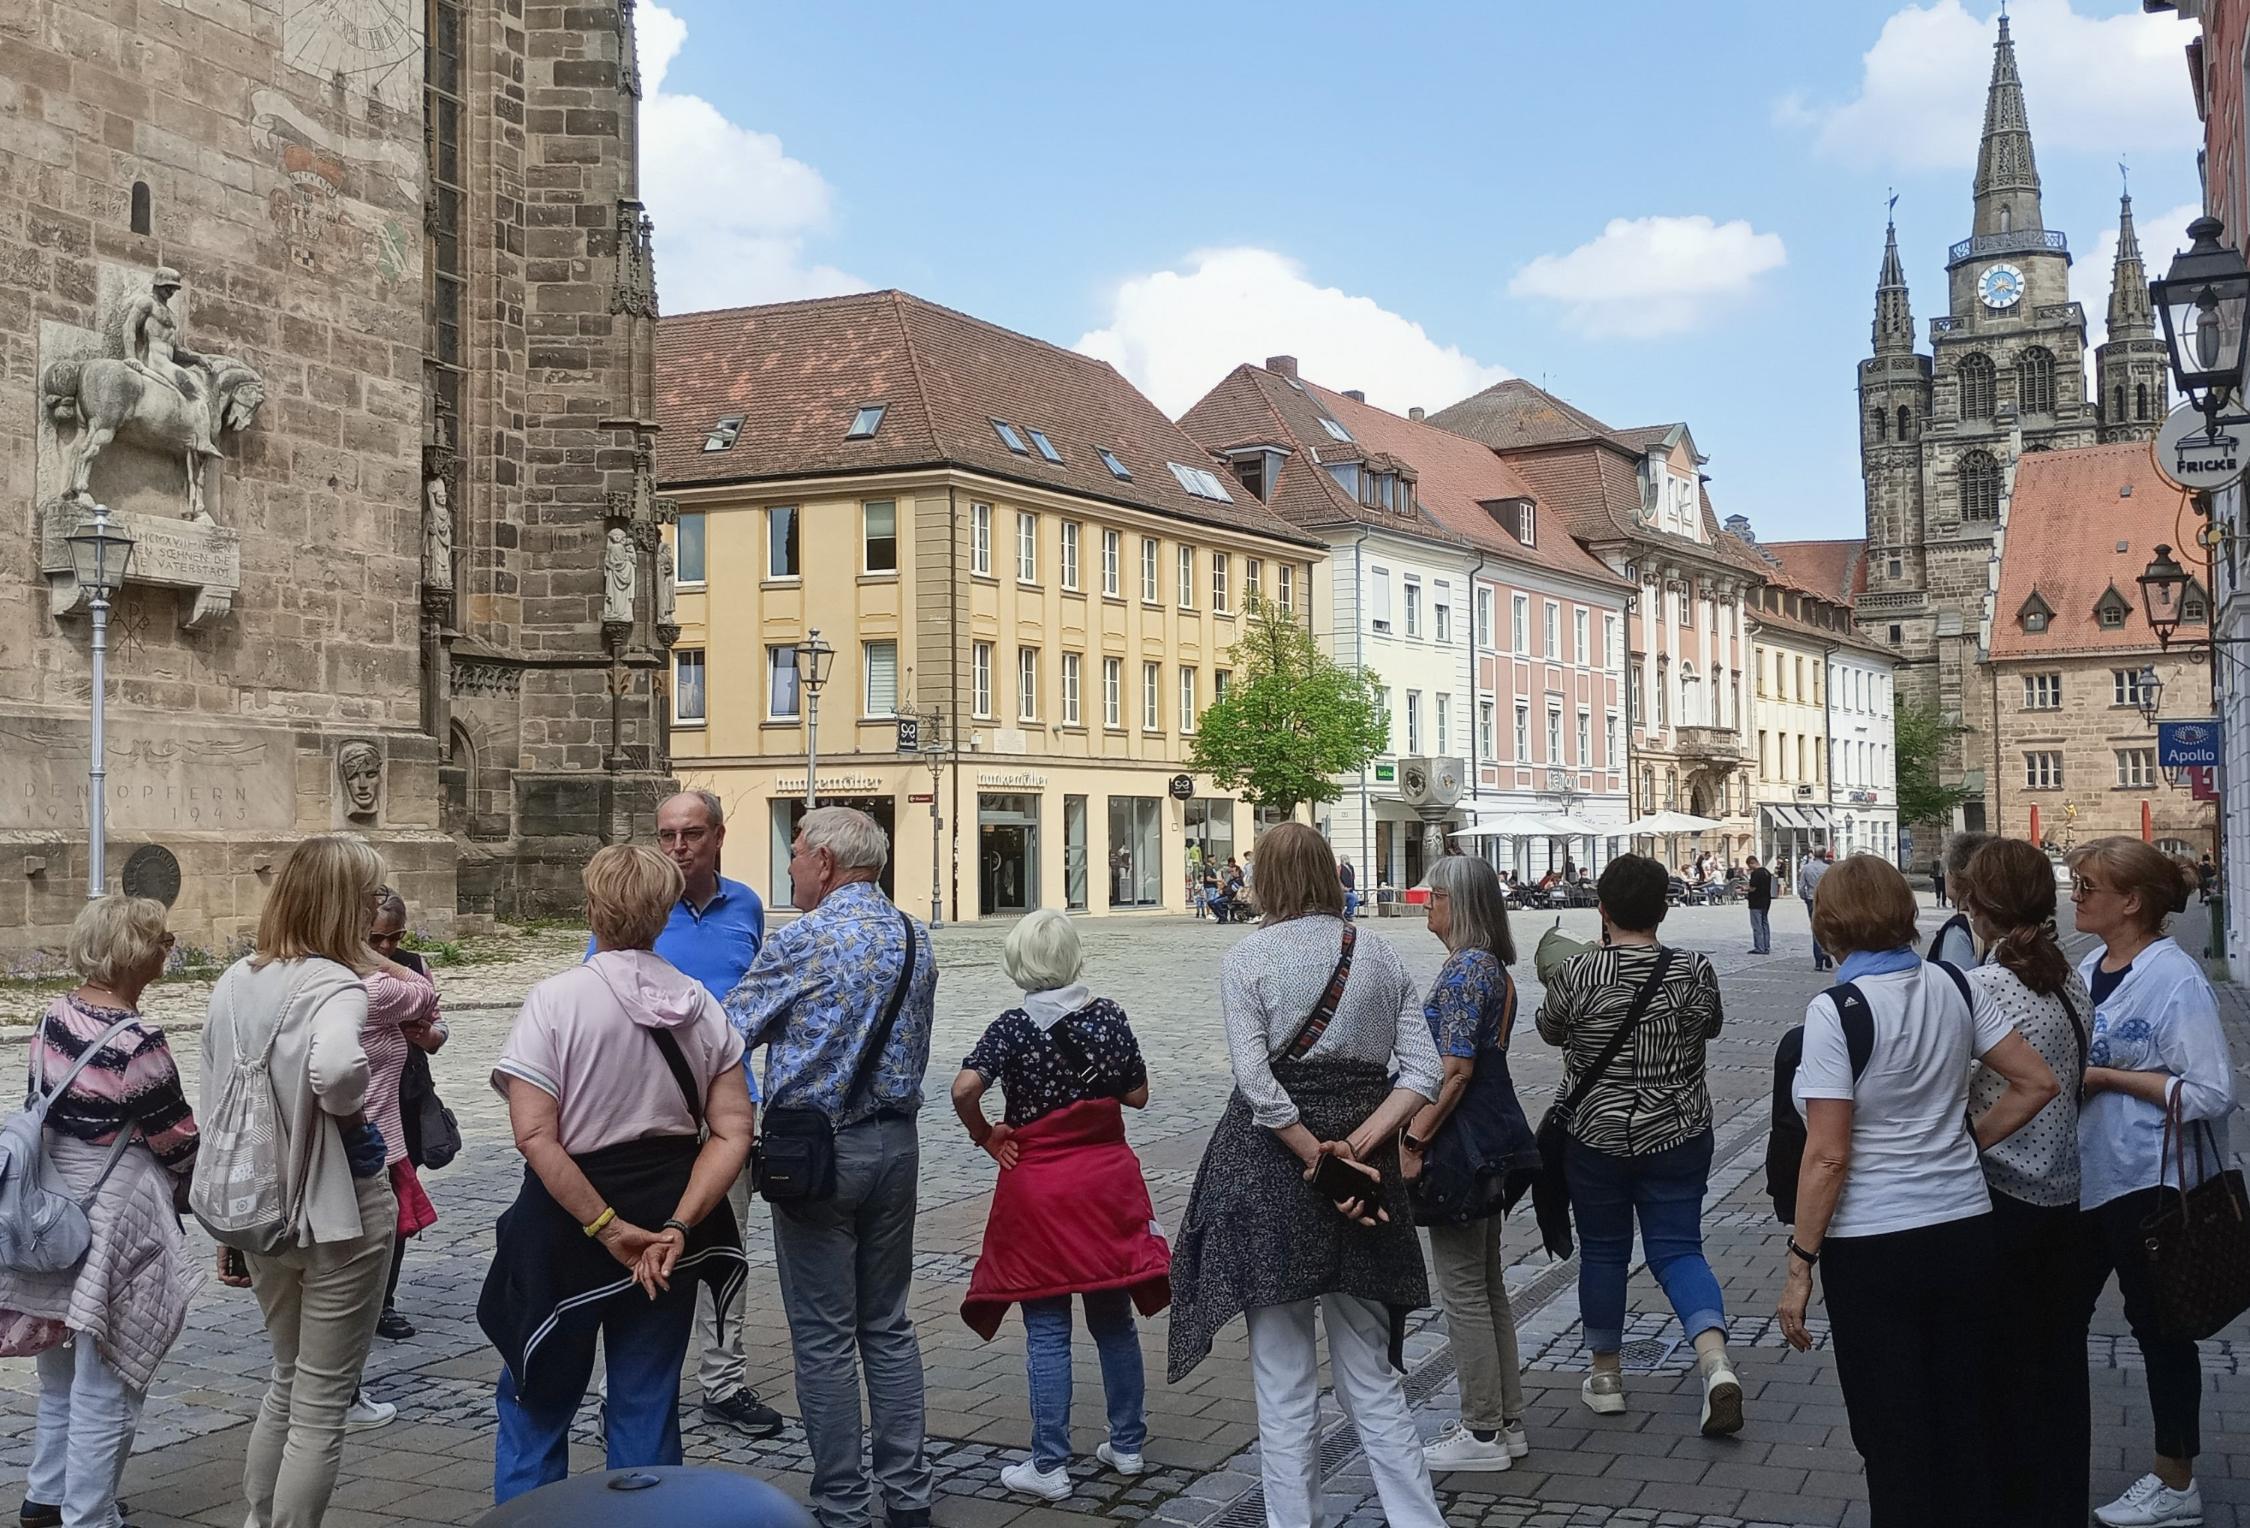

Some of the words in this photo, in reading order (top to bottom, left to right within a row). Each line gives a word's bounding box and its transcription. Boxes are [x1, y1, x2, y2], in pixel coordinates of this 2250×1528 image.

[2176, 458, 2237, 474] FRICKE
[157, 559, 230, 578] VATERSTADT
[2168, 748, 2215, 764] Apollo
[776, 770, 882, 790] hunemöller
[24, 783, 89, 799] DEN
[116, 784, 247, 801] OPFERN
[172, 807, 246, 823] 1945
